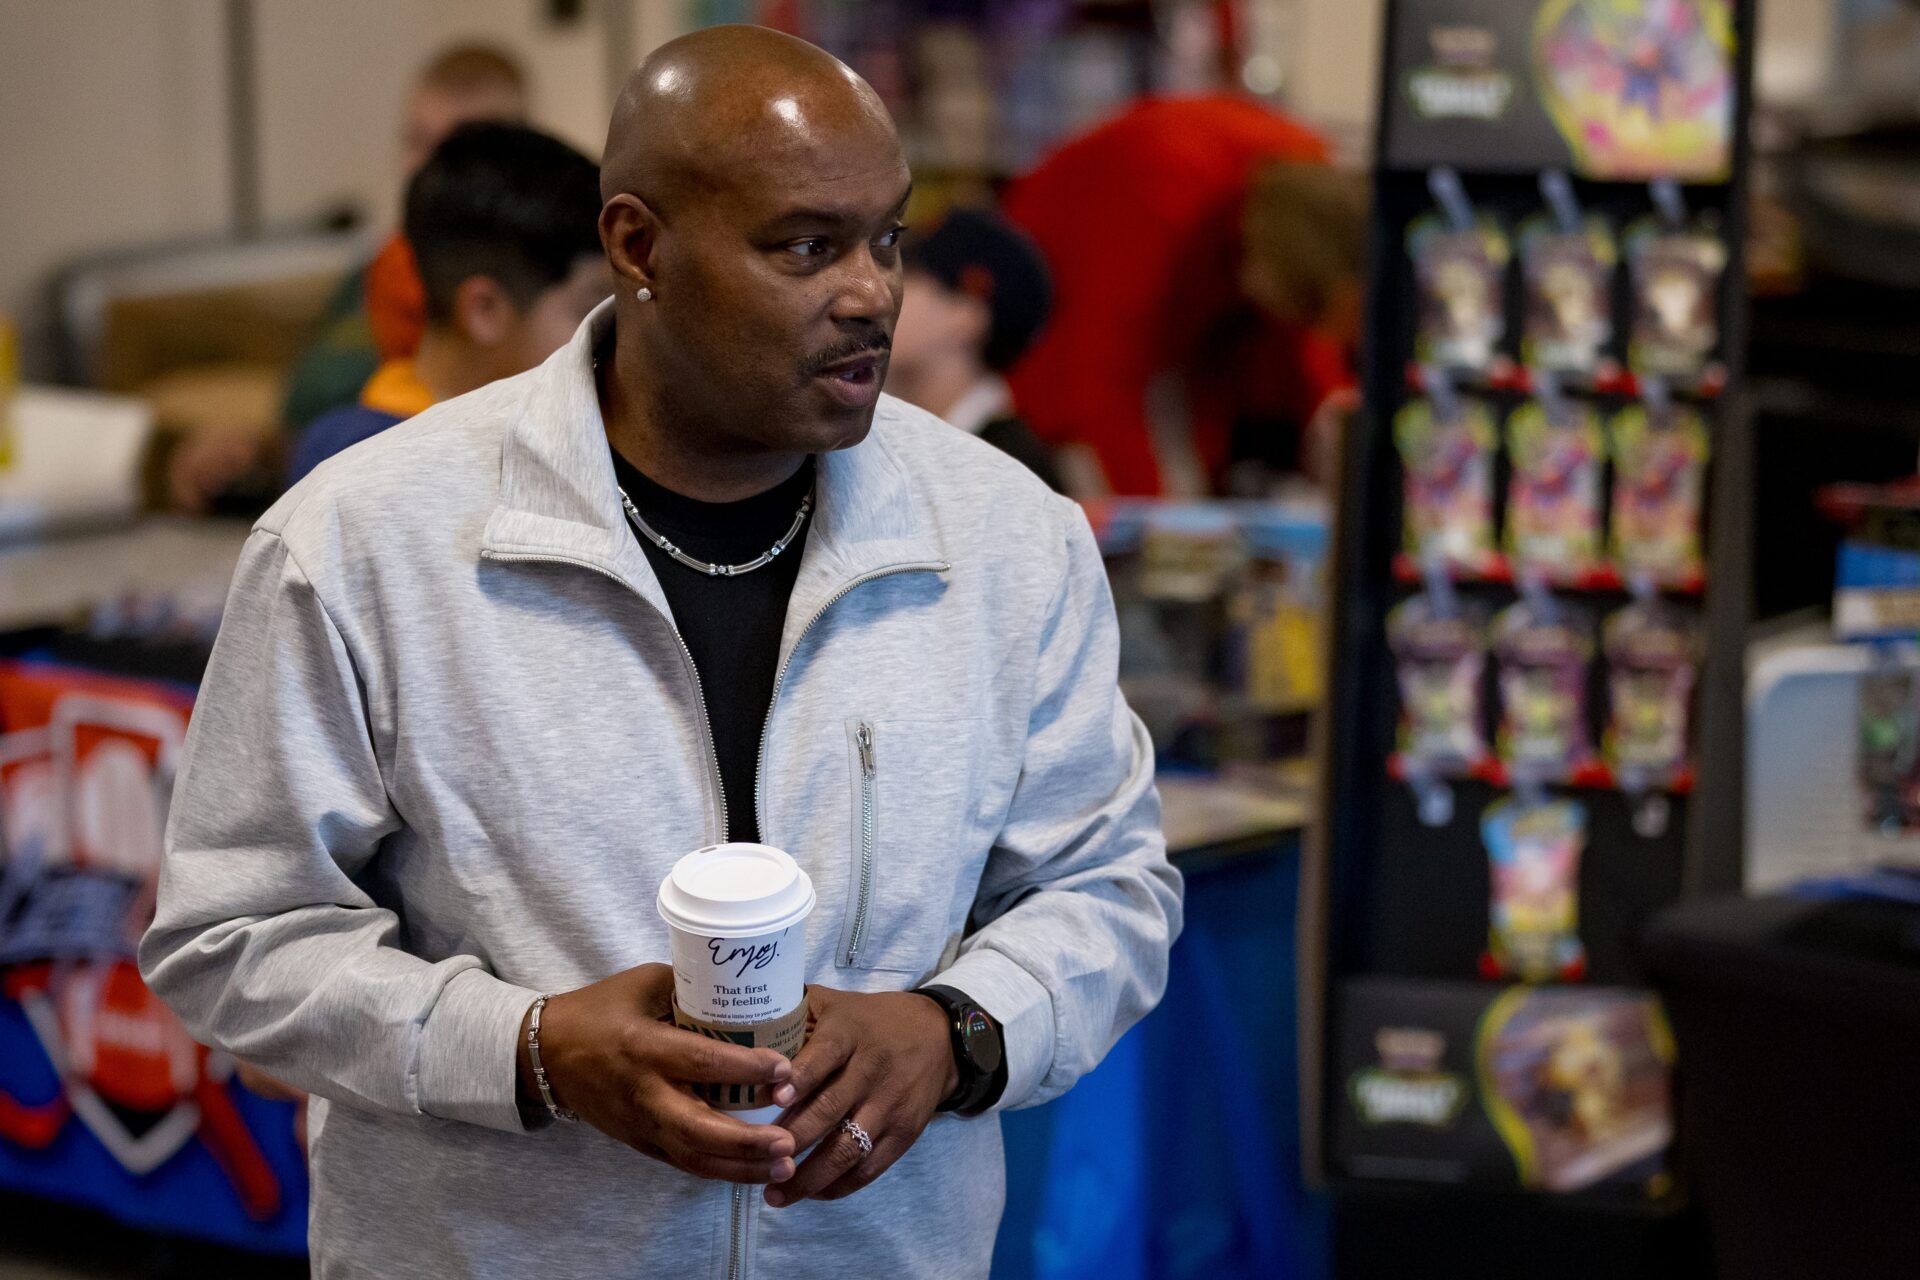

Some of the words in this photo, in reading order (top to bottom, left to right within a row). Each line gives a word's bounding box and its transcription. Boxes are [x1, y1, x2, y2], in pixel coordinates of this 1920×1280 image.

[713, 984, 741, 995] That
[745, 983, 768, 994] first
[712, 997, 729, 1008] sip
[732, 995, 773, 1007] feeling.
[761, 1010, 772, 1018] your
